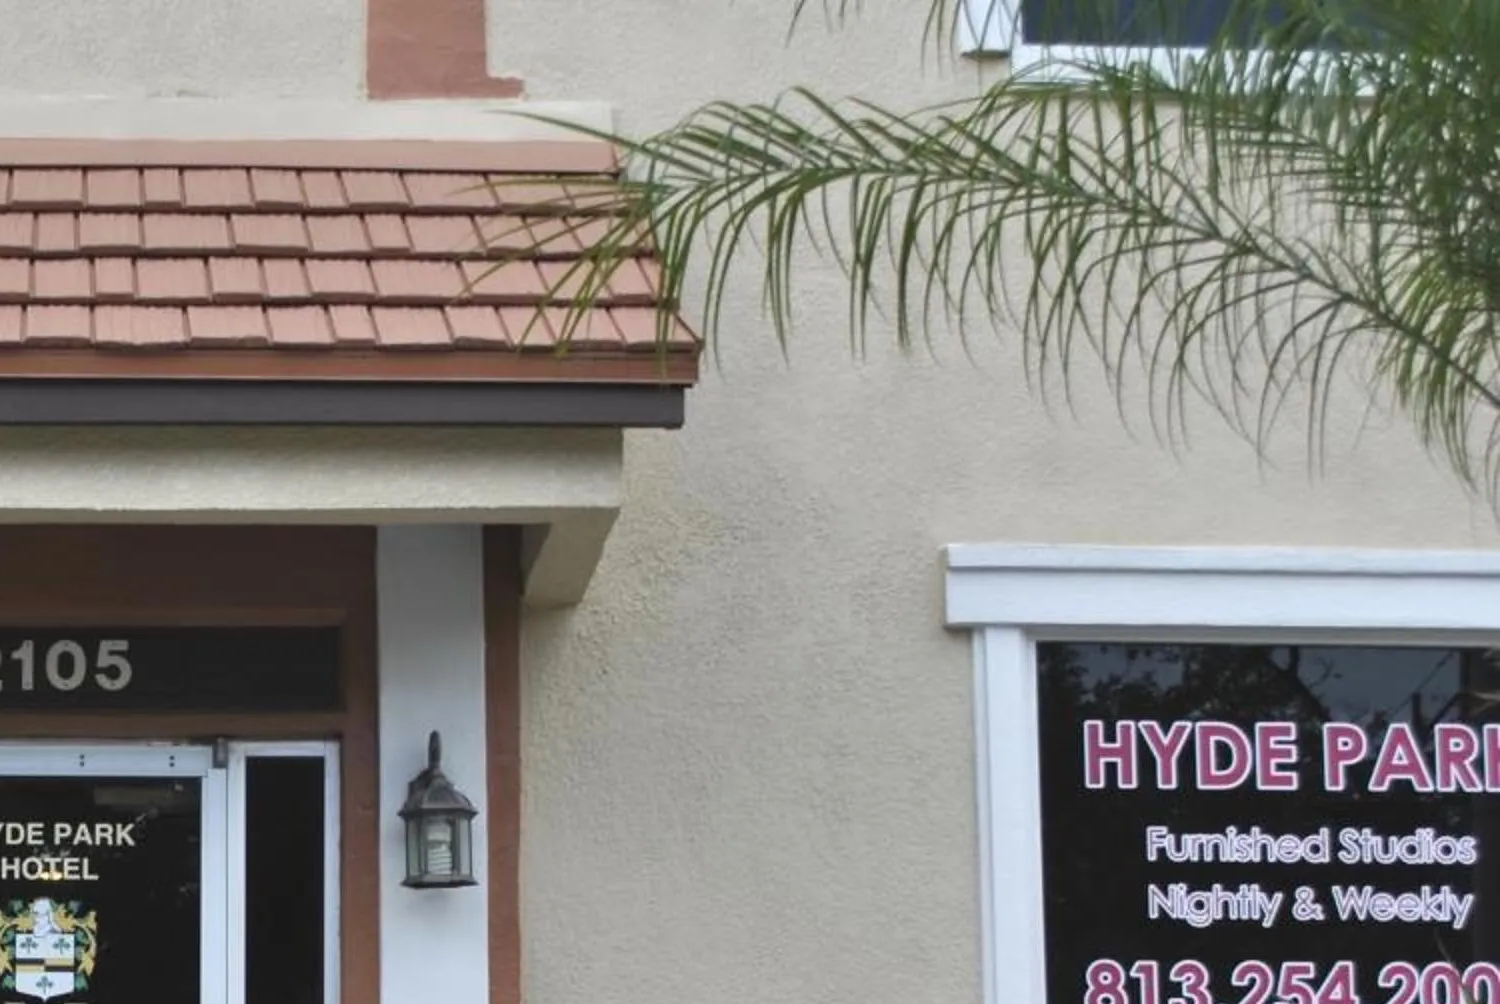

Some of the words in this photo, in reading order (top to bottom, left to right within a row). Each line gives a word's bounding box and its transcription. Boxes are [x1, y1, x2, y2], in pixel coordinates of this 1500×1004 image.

[1083, 720, 1299, 791] HYDE
[53, 822, 136, 847] PARK
[1146, 826, 1329, 863] Furnished
[1337, 827, 1478, 865] Studios
[0, 857, 100, 882] HOTEL
[1147, 883, 1283, 928] Nightly
[1291, 886, 1325, 921] &
[1331, 885, 1474, 929] Weekly
